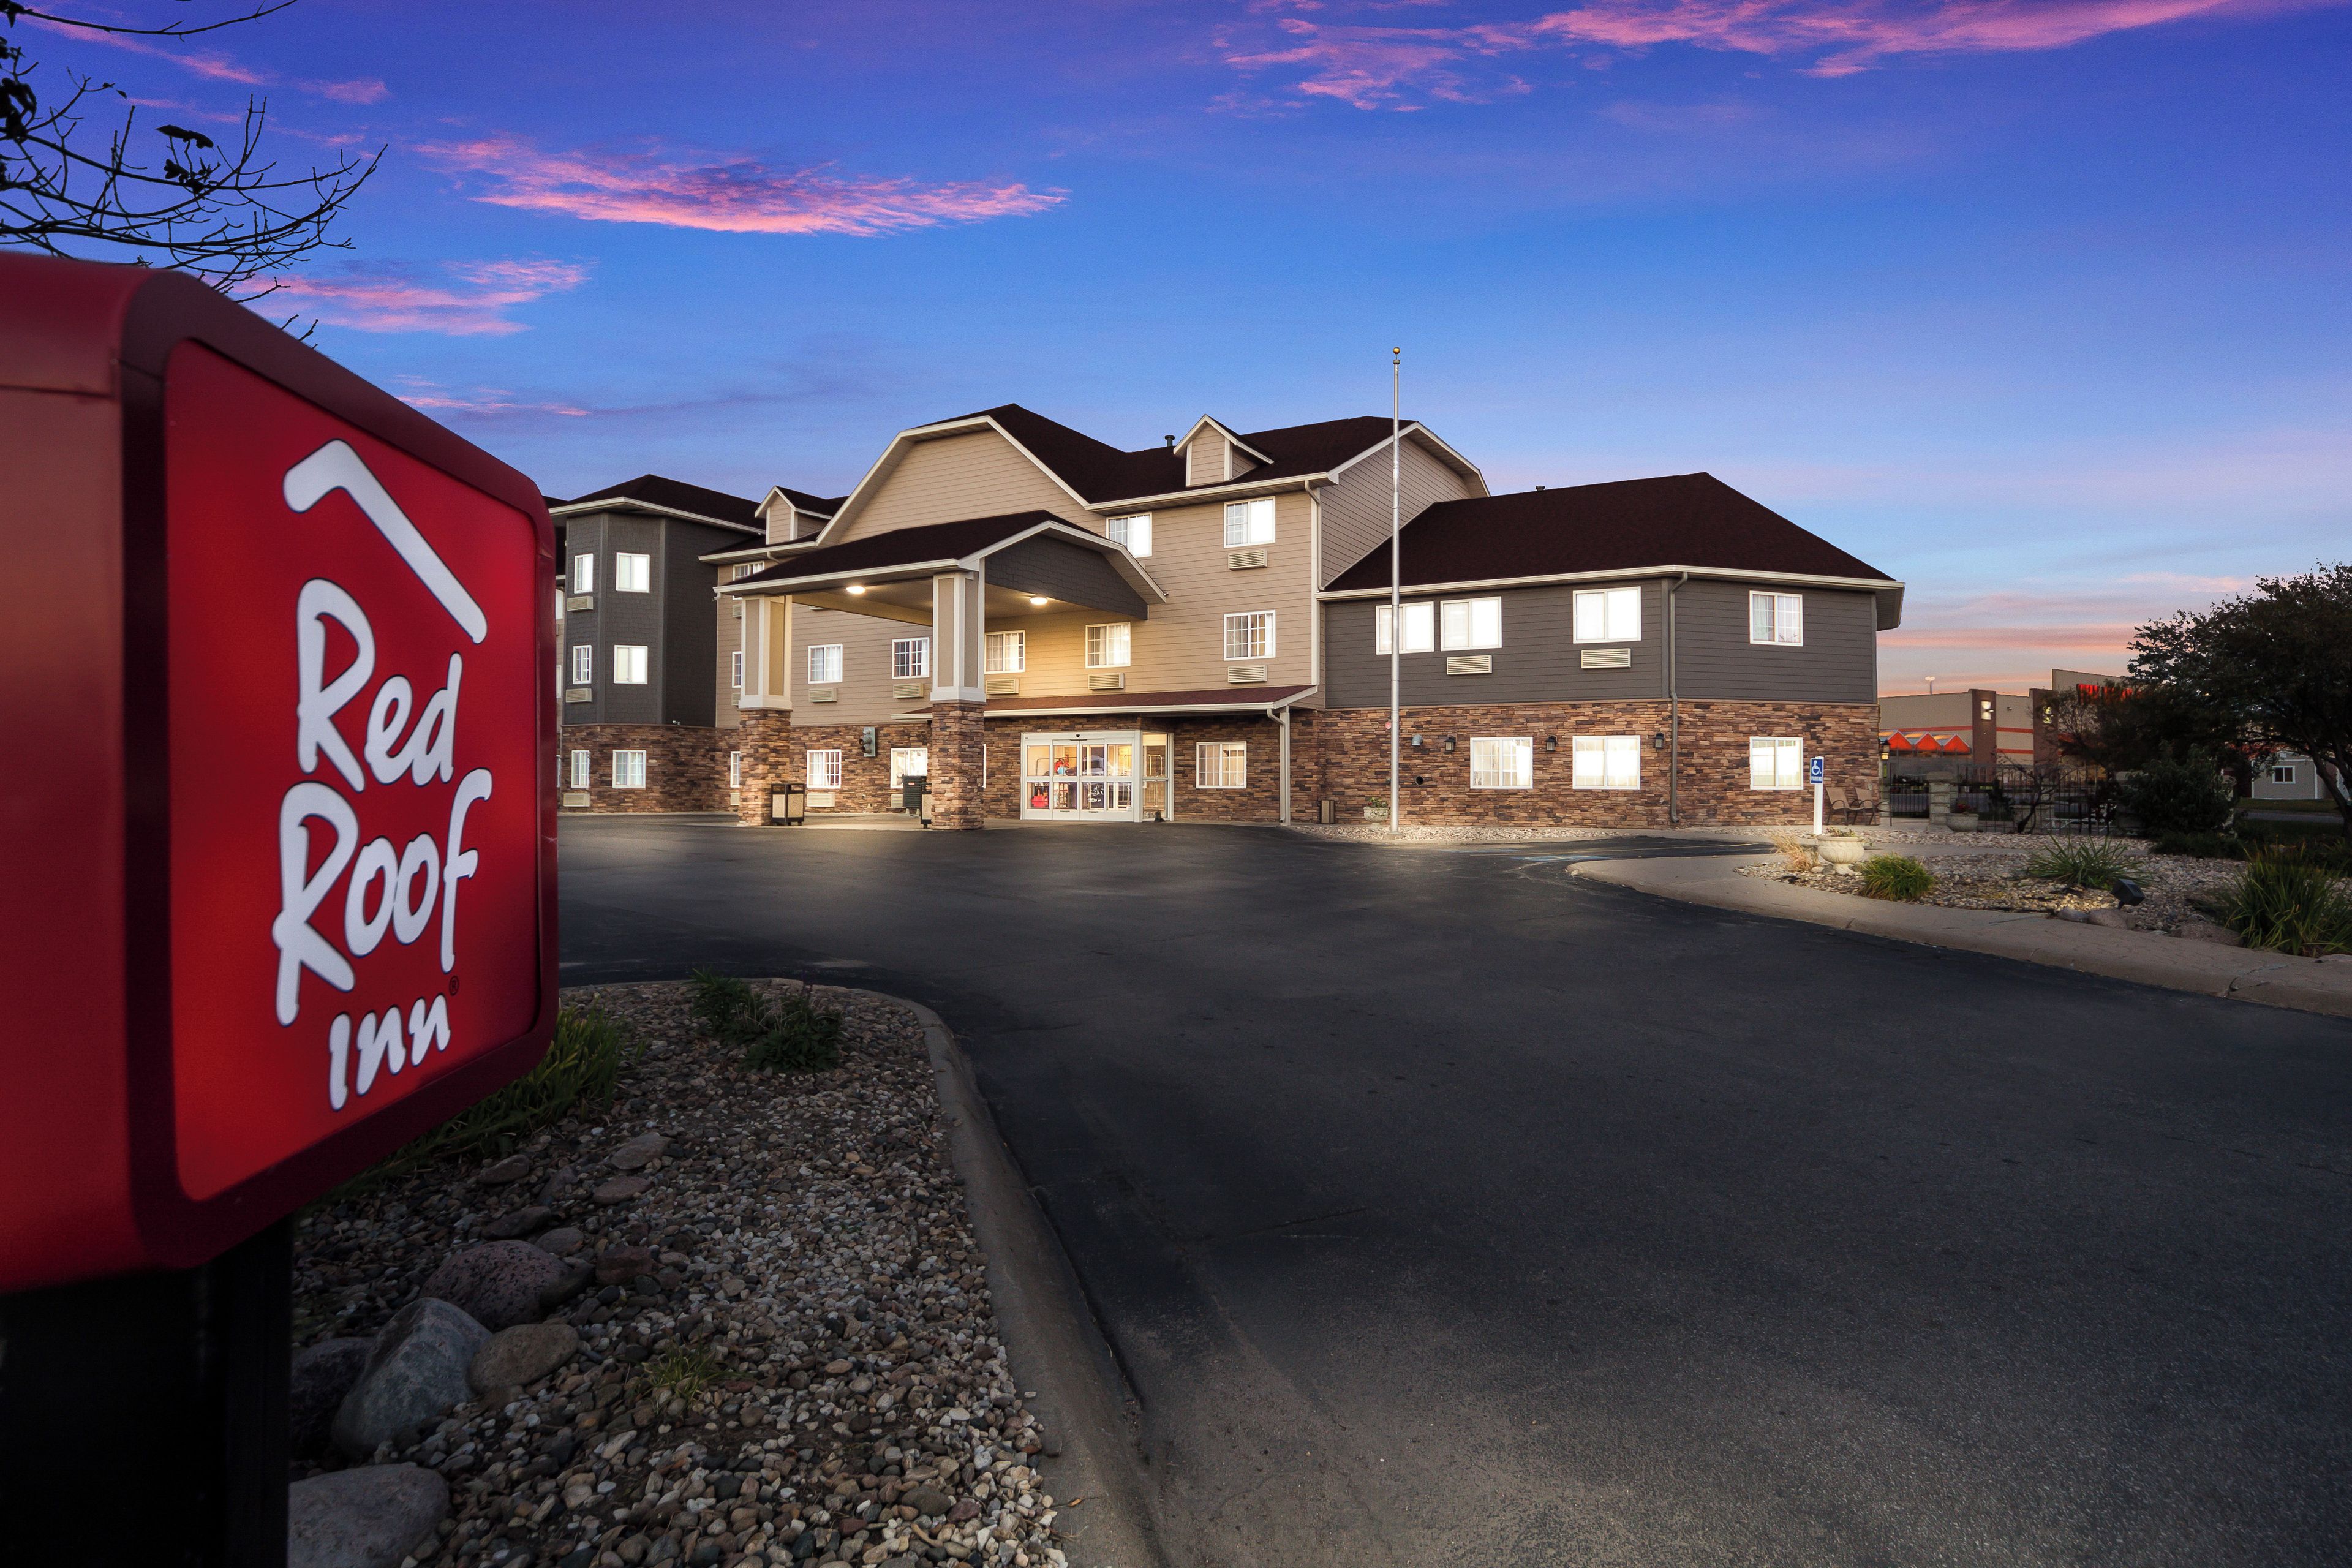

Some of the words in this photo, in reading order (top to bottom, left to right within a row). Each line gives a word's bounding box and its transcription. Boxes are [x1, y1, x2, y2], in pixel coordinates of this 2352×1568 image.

[297, 579, 462, 792] Red
[272, 768, 493, 1026] Roof
[329, 994, 451, 1109] Inn
